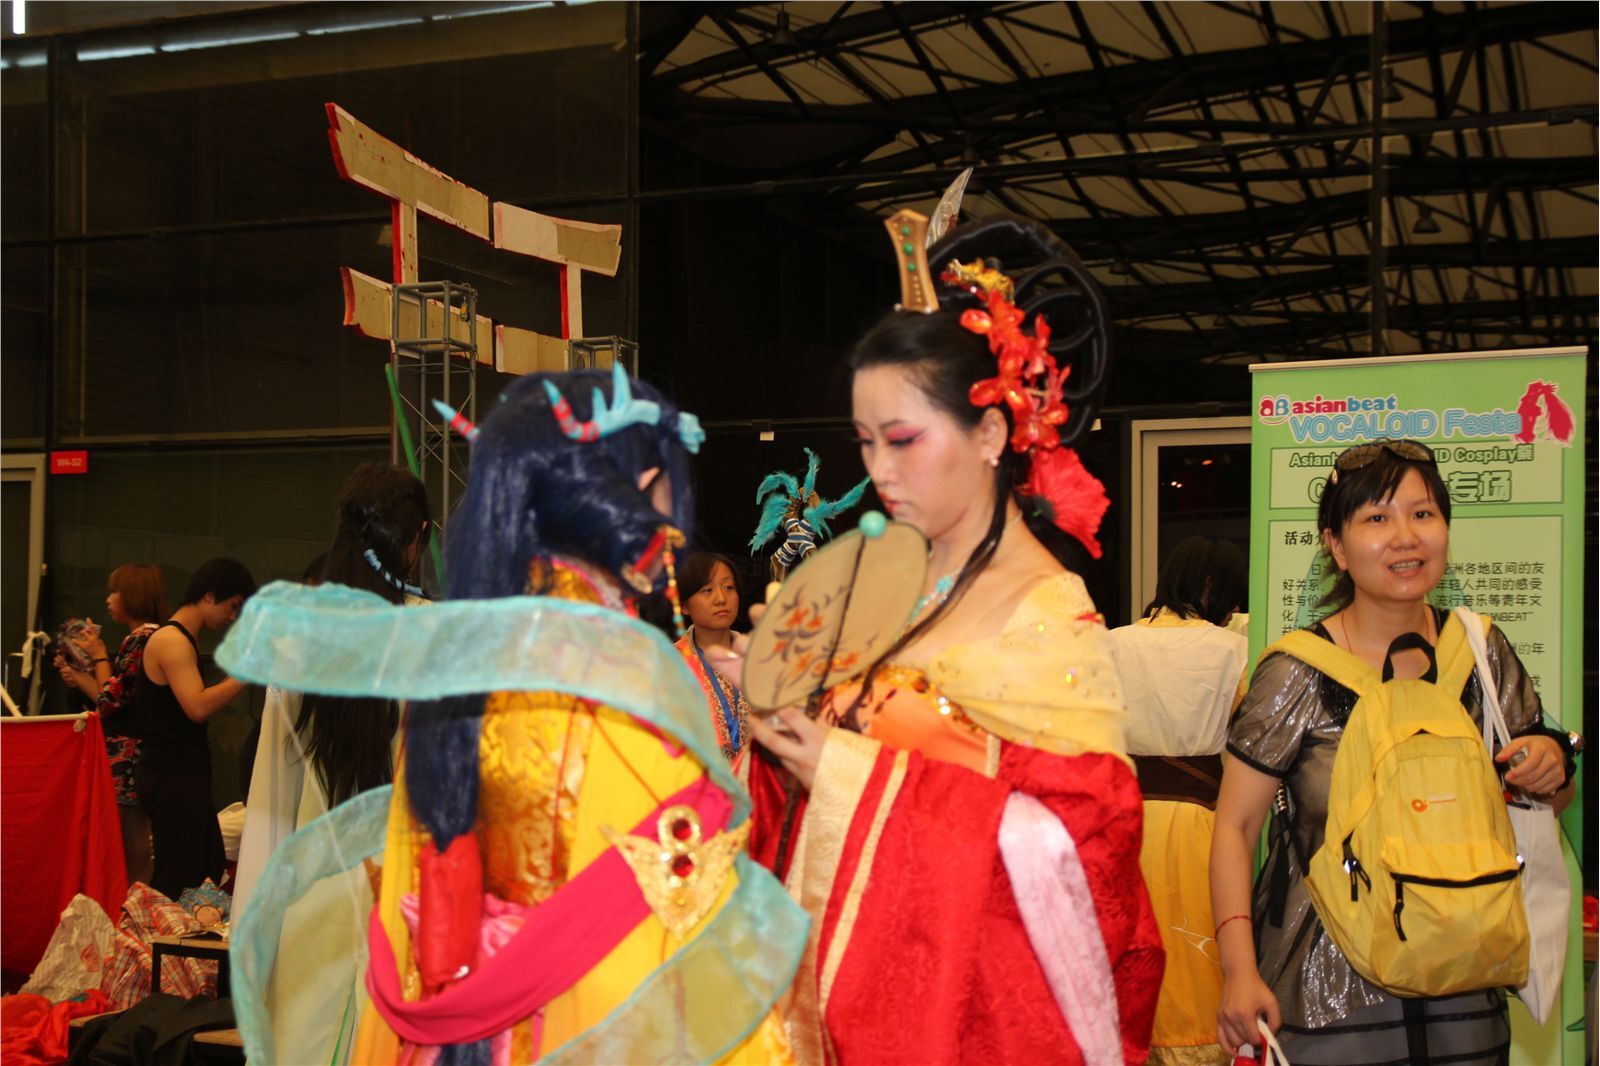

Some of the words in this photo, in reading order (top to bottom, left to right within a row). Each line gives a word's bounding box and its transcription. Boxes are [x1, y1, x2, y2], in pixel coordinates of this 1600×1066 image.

[1292, 394, 1397, 414] asianbeat
[1289, 411, 1438, 442] VOCALOID
[1443, 408, 1523, 438] Festa
